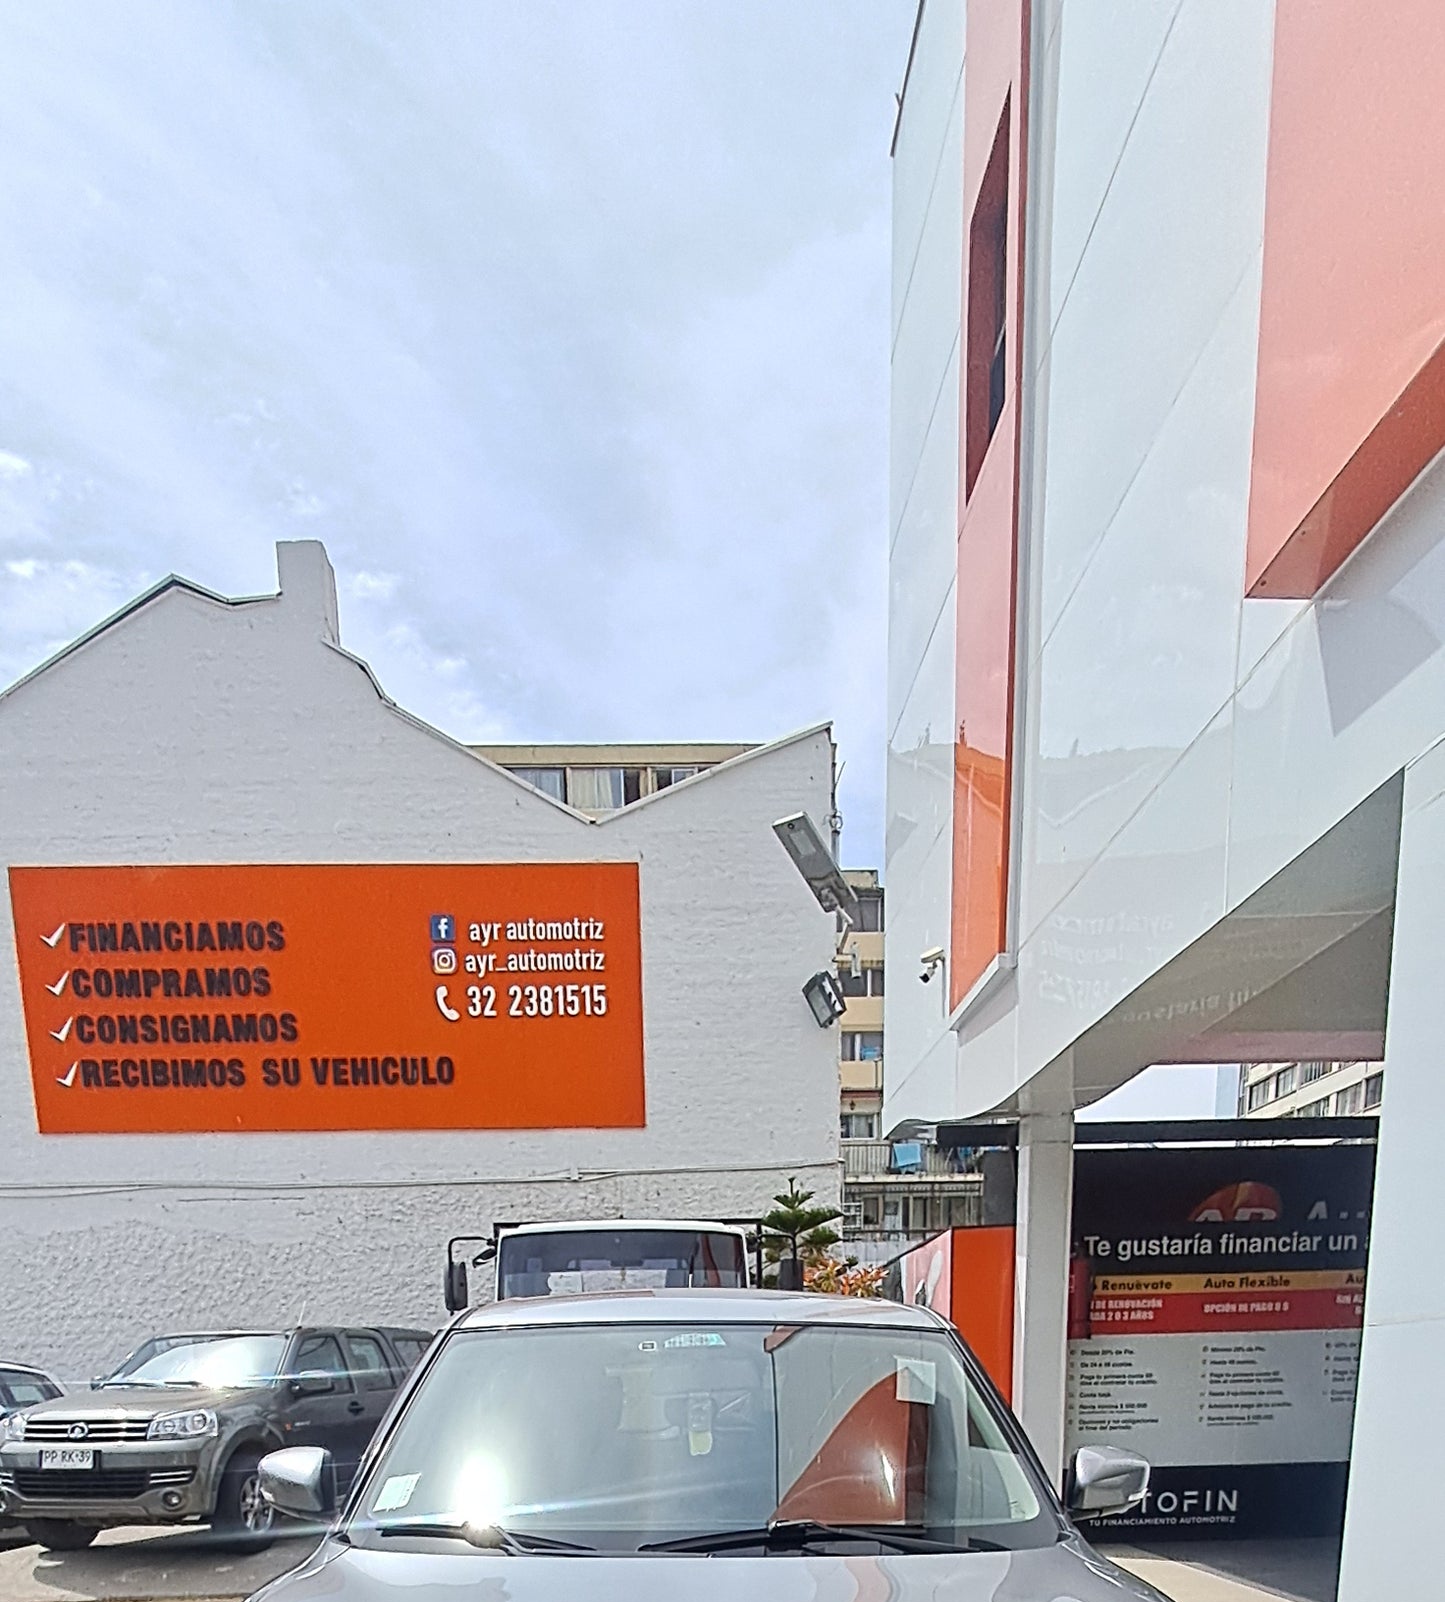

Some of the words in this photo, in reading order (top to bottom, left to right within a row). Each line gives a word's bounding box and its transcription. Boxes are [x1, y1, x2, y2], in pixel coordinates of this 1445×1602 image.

[68, 920, 286, 952] FINANCIAMOS
[469, 922, 501, 947] ayr
[506, 917, 605, 941] automotriz
[465, 948, 605, 978] ayr_automotriz
[71, 966, 271, 998] COMPRAMOS
[467, 985, 497, 1016] 32
[508, 984, 607, 1016] 2381515
[75, 1013, 298, 1044] CONSIGNAMOS
[80, 1058, 246, 1088] RECIBIMOS
[262, 1057, 300, 1087] SU
[311, 1056, 454, 1086] VEHICULO
[1083, 1235, 1111, 1256] Te
[1117, 1232, 1212, 1261] gustaría
[1219, 1231, 1321, 1254] financiar
[1328, 1233, 1357, 1251] un
[1203, 1277, 1235, 1289] Auto
[1239, 1275, 1290, 1288] Flexible
[1103, 1516, 1177, 1527] FINANCIAMIENTO
[1179, 1515, 1236, 1525] AUTOMOTRIZ
